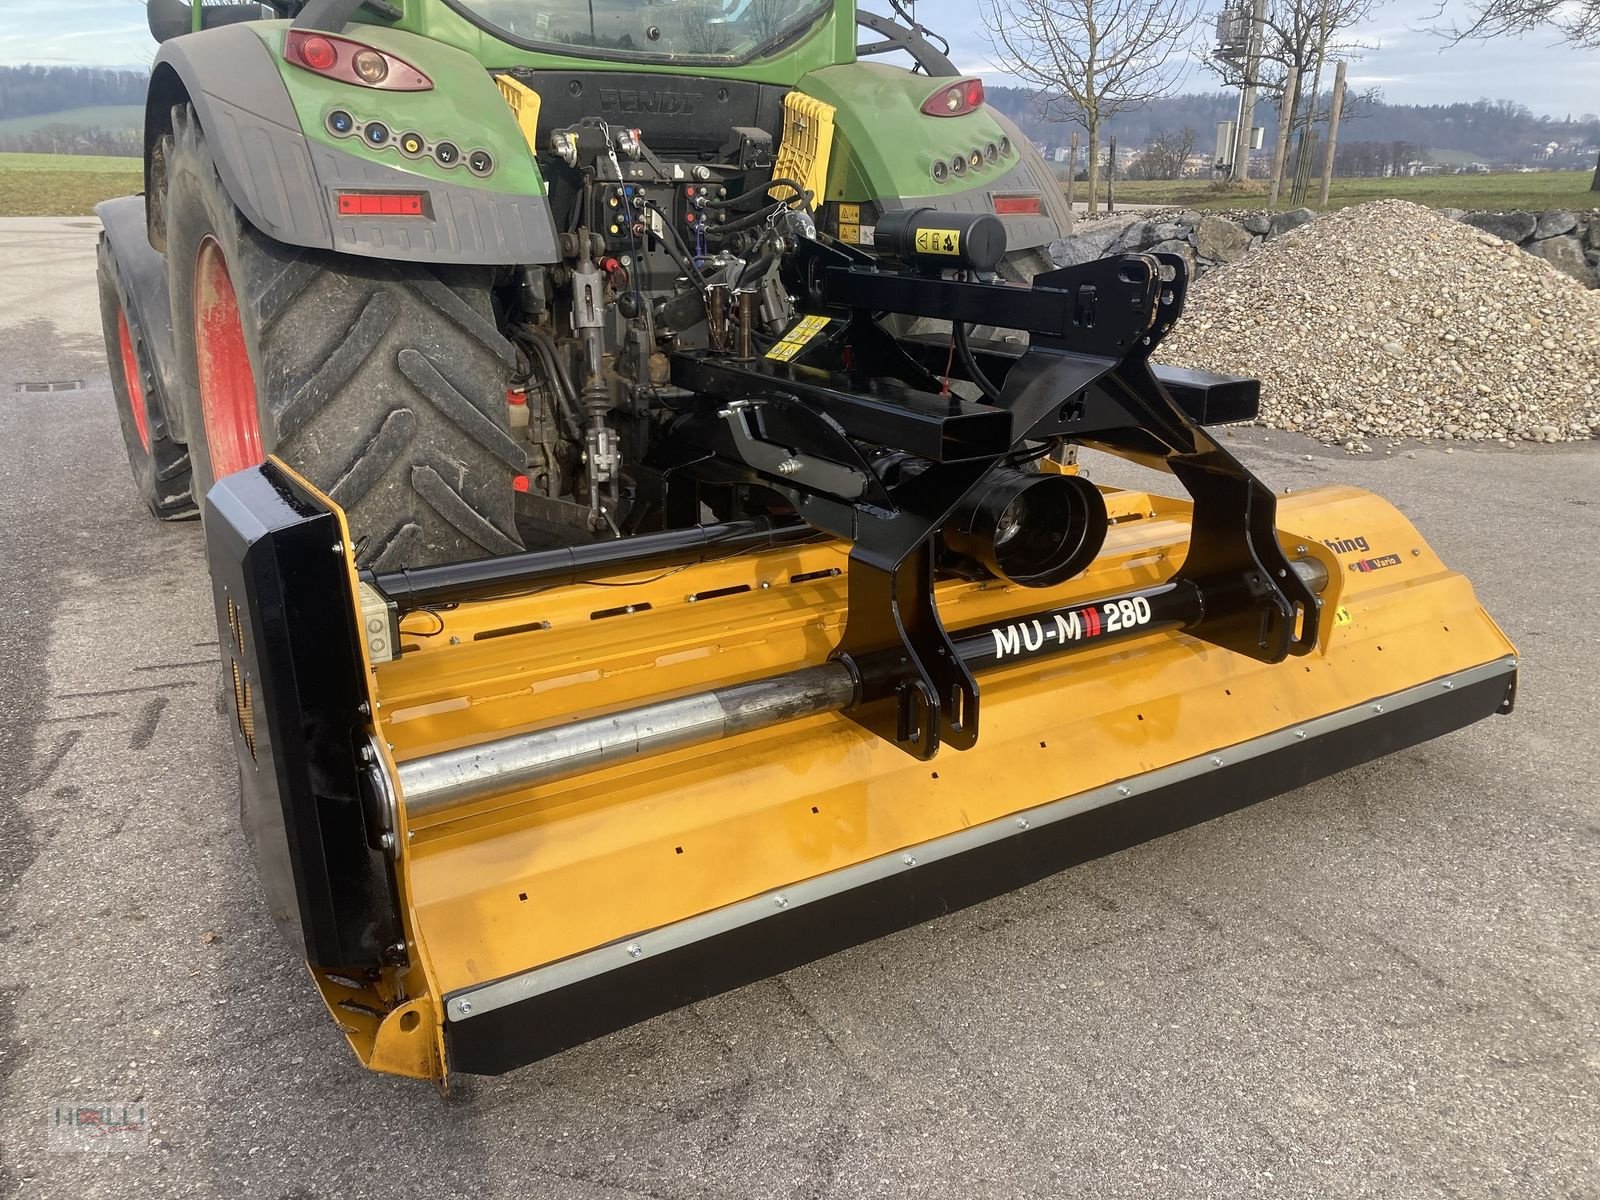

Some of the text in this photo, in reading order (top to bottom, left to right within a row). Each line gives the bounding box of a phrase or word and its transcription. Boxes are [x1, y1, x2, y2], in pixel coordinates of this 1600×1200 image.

[599, 88, 704, 116] FENDT
[1373, 556, 1397, 568] Vario
[1103, 596, 1152, 633] 280
